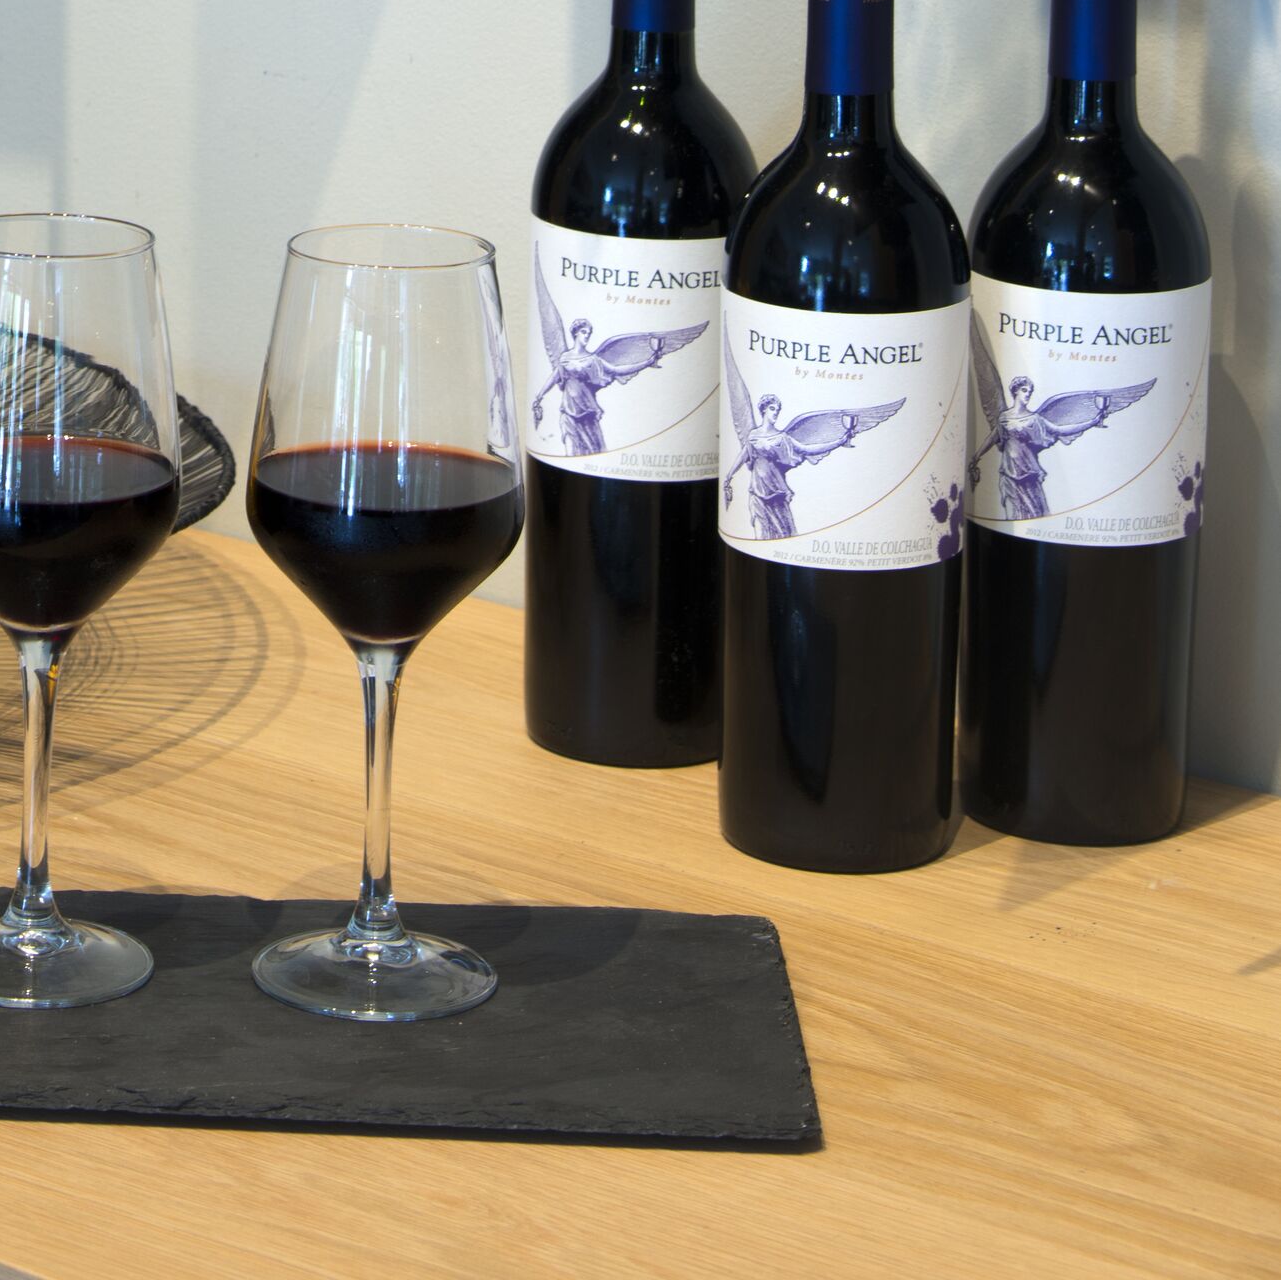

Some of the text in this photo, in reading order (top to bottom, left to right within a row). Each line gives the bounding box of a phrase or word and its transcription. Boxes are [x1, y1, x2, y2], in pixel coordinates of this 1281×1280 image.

[561, 256, 721, 289] PURPLE ANGEL
[606, 293, 671, 306] by Montes
[999, 312, 1084, 345] PURPLE
[749, 329, 831, 363] PURPLE
[1048, 349, 1117, 363] by Montes
[795, 367, 864, 381] by Montes
[1064, 516, 1084, 530] D.O.
[1087, 517, 1116, 532] VALLE
[1118, 517, 1132, 531] DE
[812, 537, 933, 556] D.O. VALLE DE COLCHAGUA
[867, 556, 890, 567] PETIT
